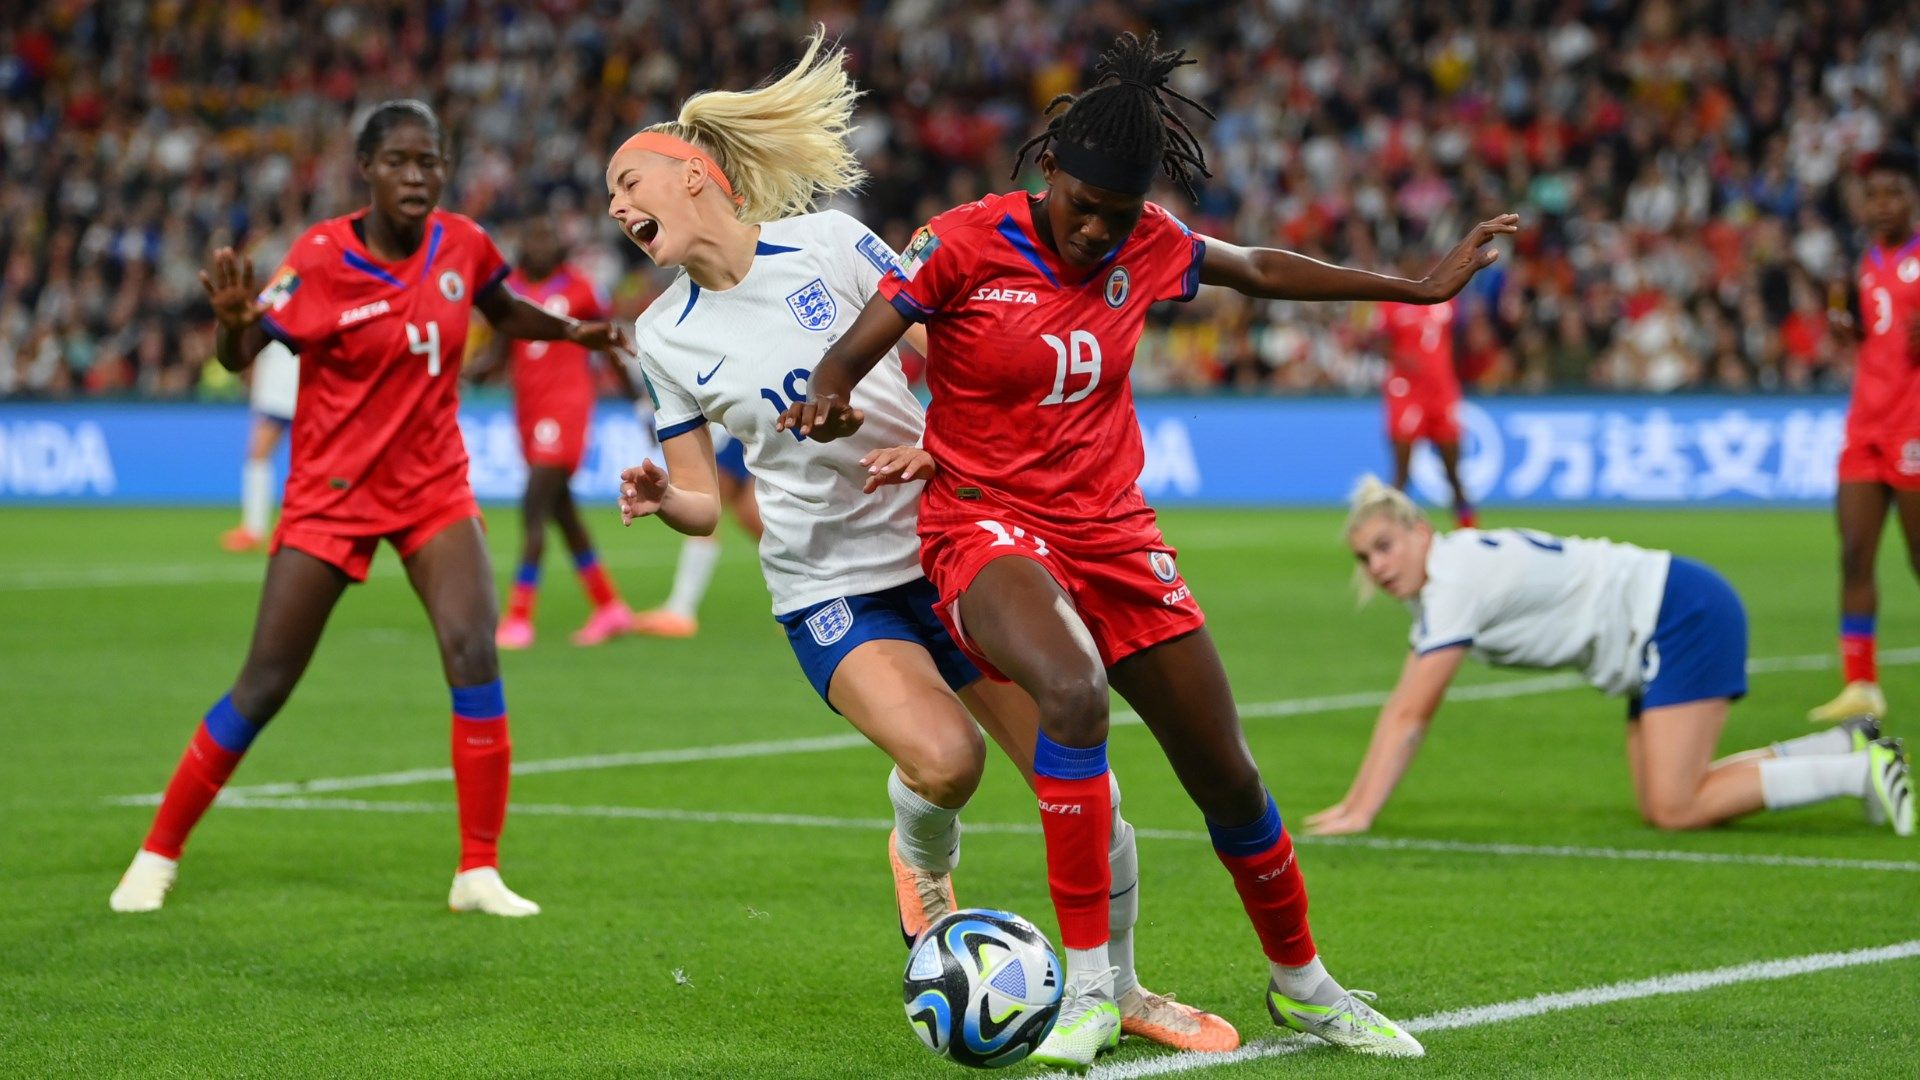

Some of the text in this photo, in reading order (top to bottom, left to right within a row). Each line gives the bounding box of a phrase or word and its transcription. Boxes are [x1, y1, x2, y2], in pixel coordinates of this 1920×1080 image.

[970, 288, 1037, 304] SAETA
[1872, 286, 1893, 335] 3
[405, 321, 440, 377] 4
[1038, 330, 1102, 406] 19
